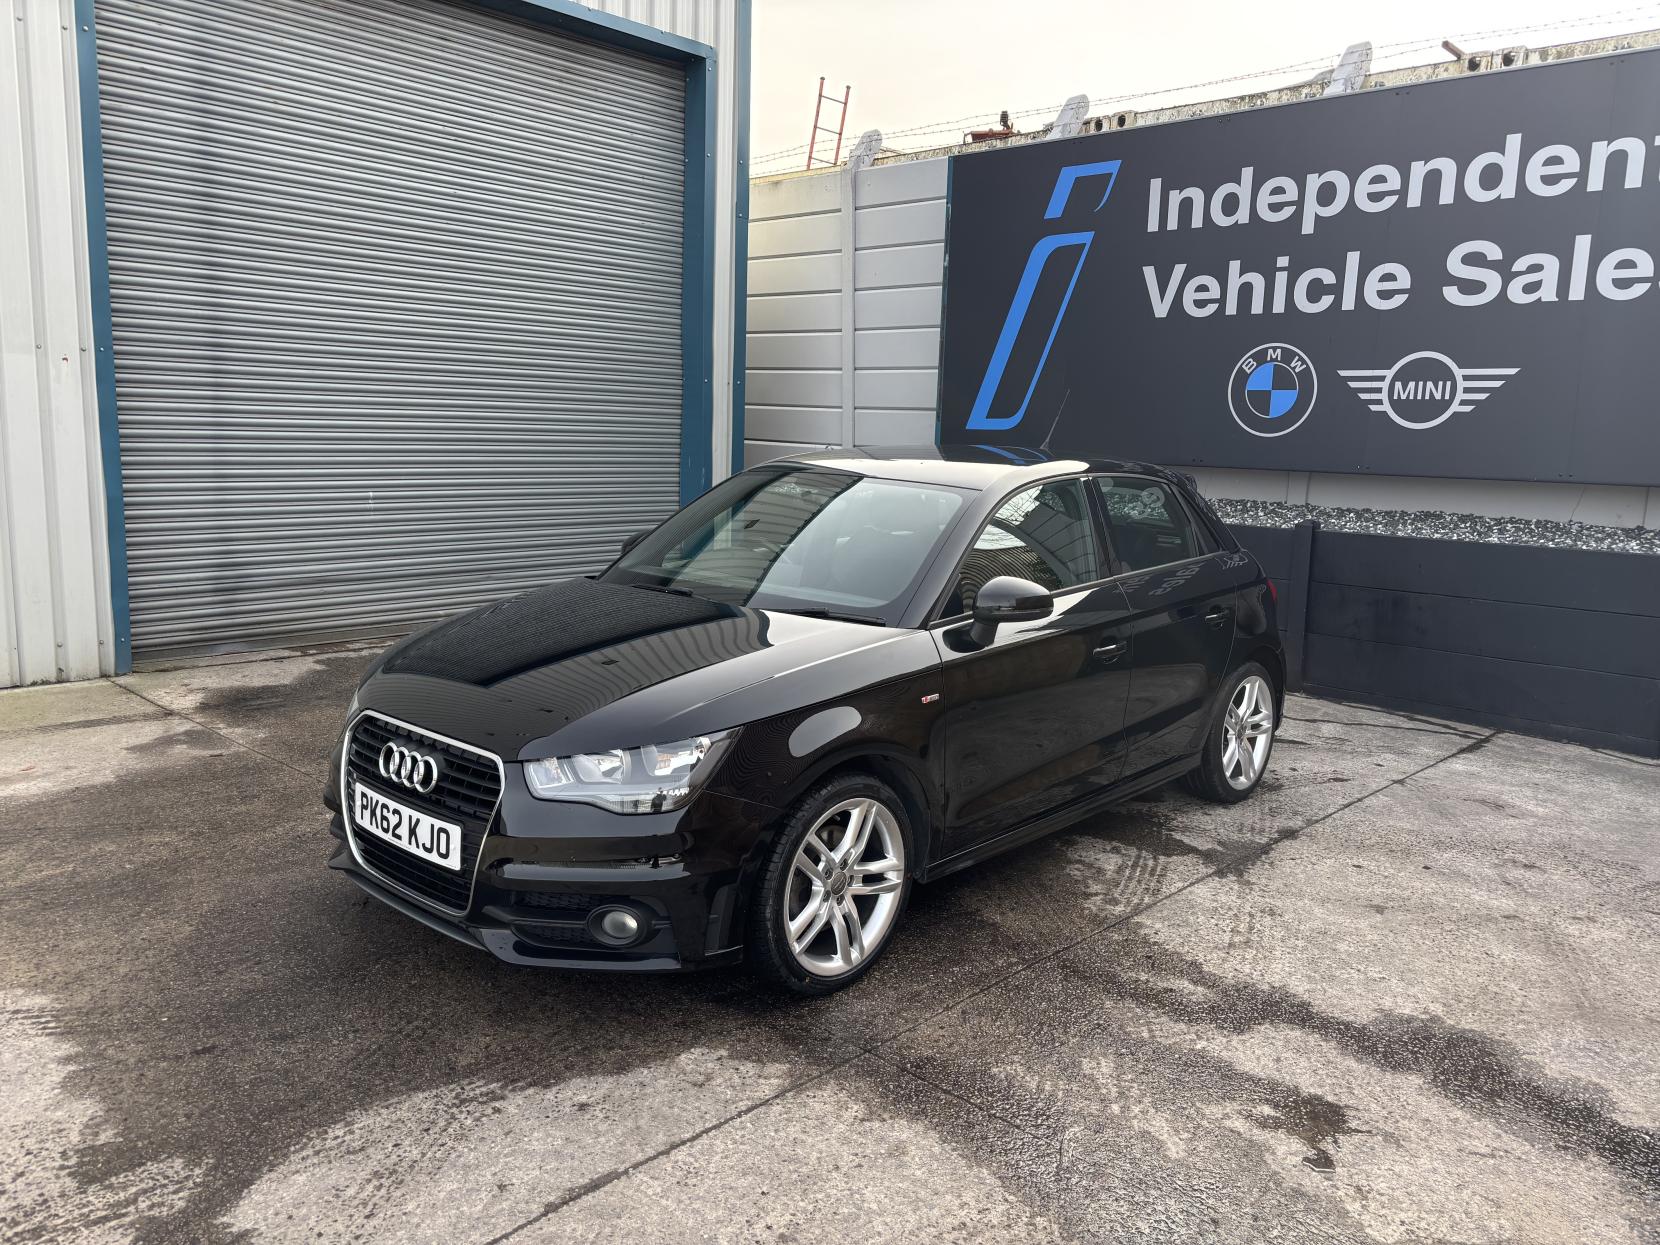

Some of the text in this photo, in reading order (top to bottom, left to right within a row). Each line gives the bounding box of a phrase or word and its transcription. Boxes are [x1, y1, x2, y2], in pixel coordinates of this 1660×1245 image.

[1147, 133, 1660, 235] Independen
[1142, 234, 1660, 318] Vehicle Sale
[1242, 348, 1307, 374] BMW
[1393, 380, 1451, 400] MINI
[360, 790, 451, 860] PK62 KJO
